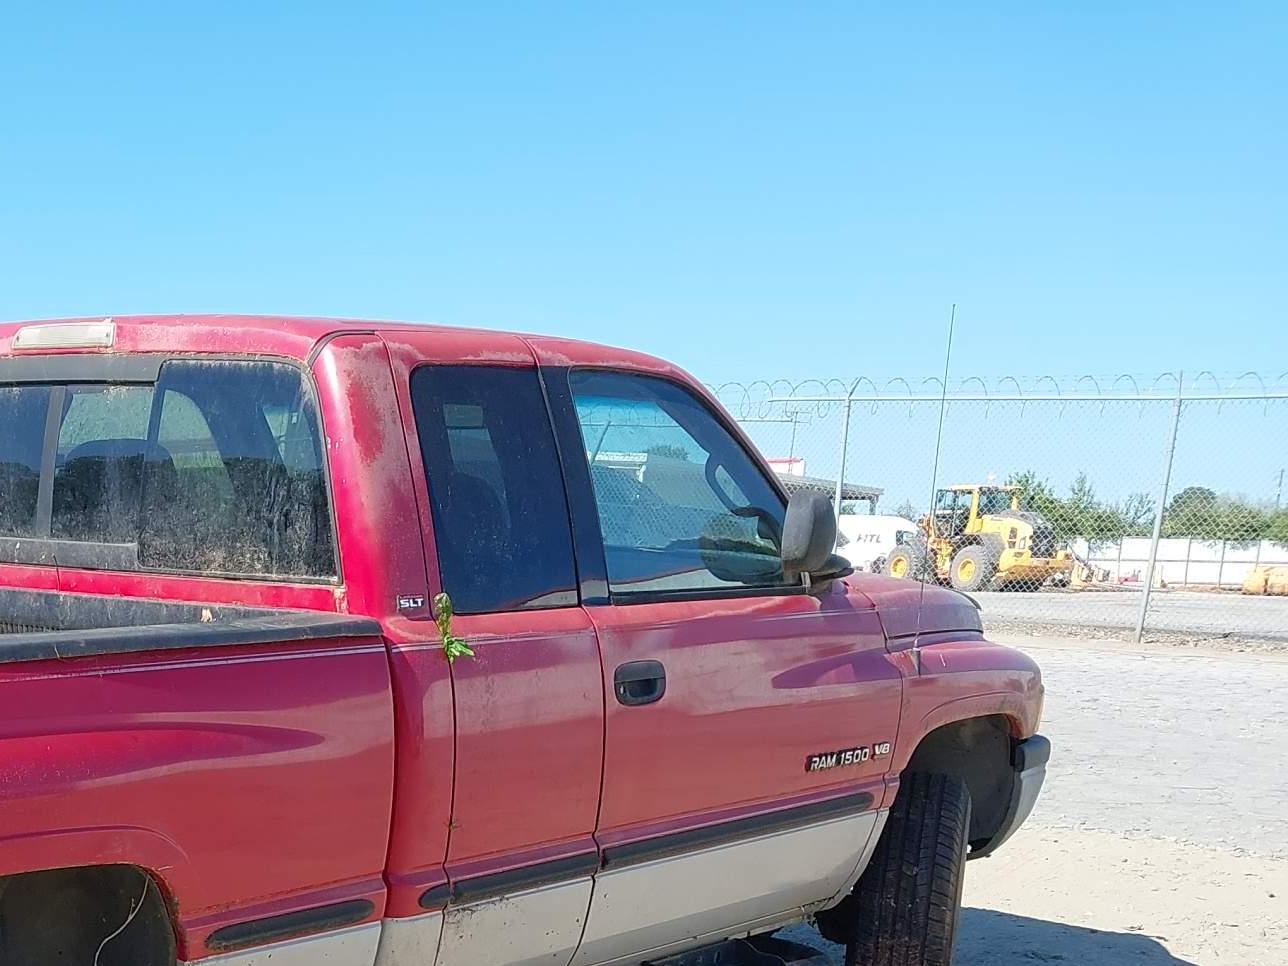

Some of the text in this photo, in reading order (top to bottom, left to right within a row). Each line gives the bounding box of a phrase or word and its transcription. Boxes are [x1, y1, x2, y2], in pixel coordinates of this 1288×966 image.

[399, 598, 423, 608] SLT
[811, 743, 890, 770] RAM 1500 V8
